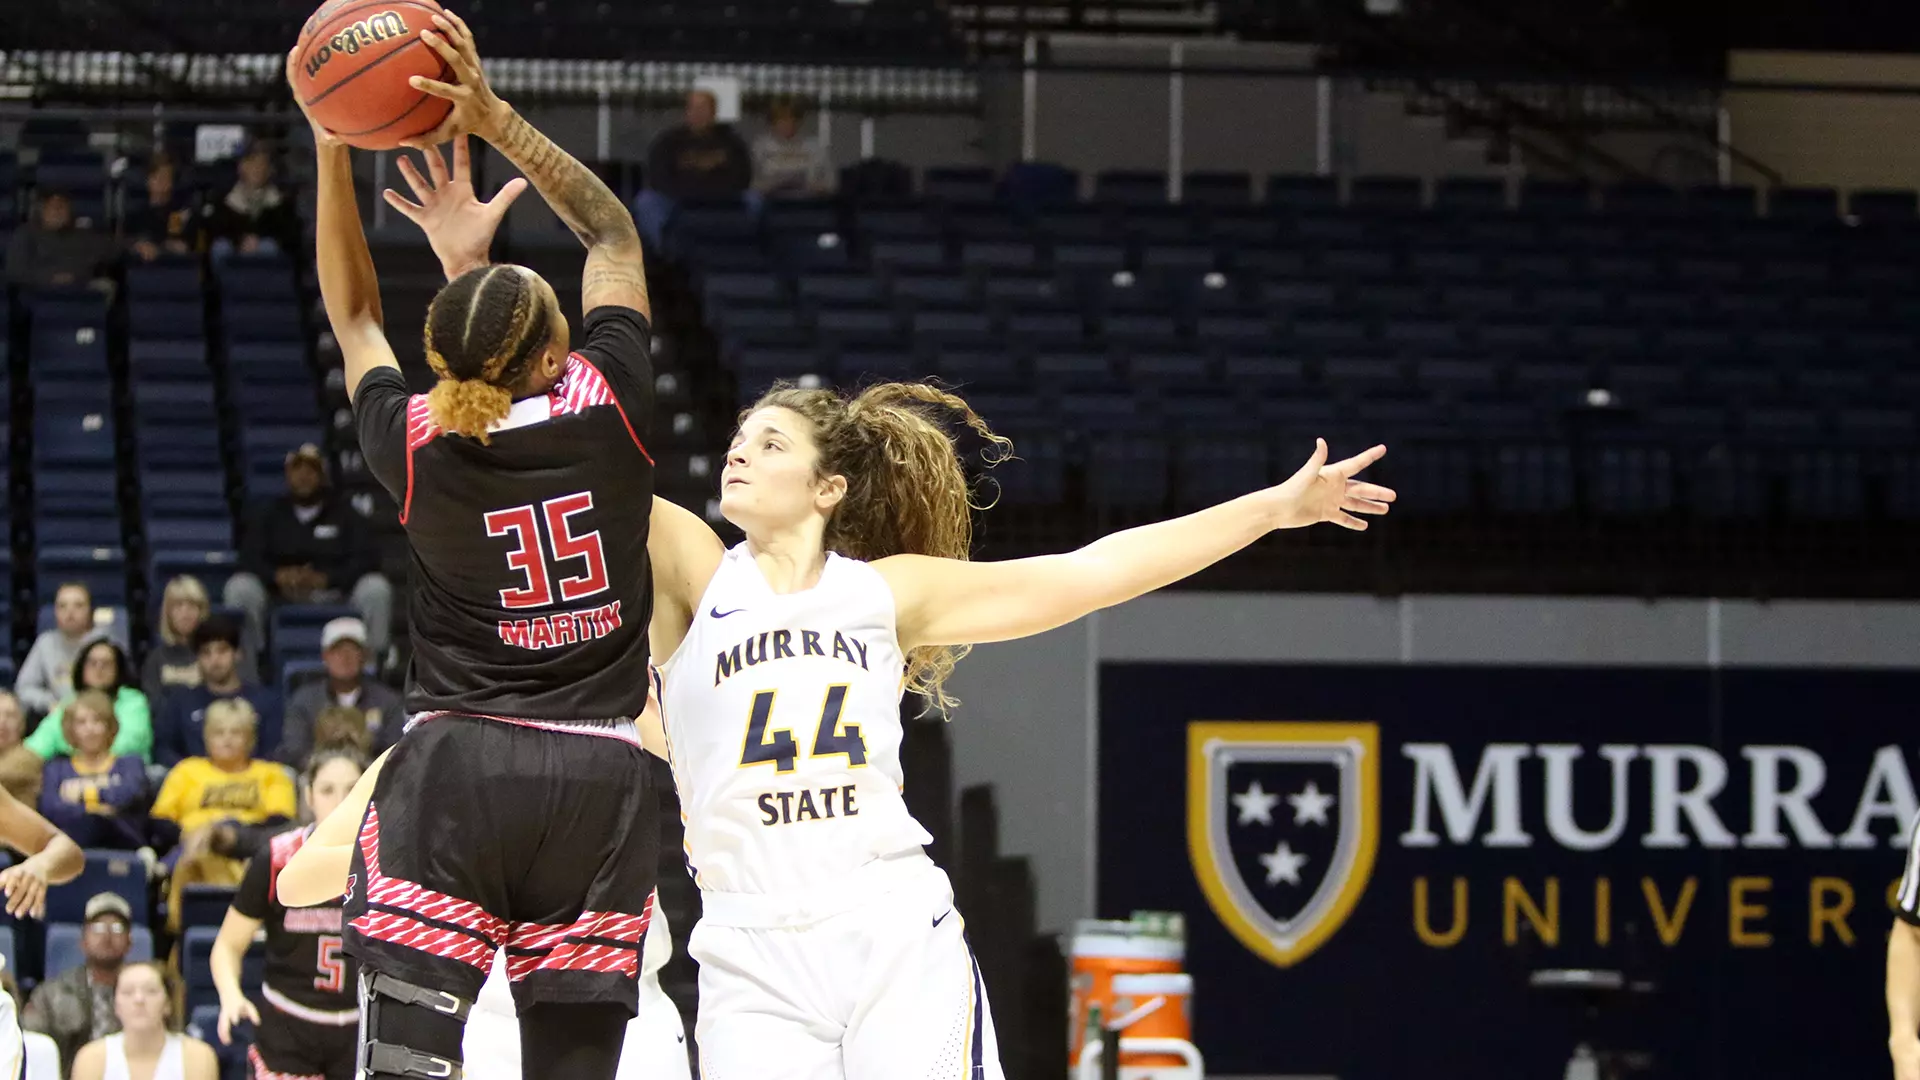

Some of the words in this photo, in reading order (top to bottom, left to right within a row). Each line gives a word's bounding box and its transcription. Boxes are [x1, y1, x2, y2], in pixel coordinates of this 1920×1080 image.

[305, 10, 410, 78] Wilson
[483, 491, 610, 609] 35
[498, 600, 623, 650] MARTIN
[714, 629, 870, 688] MURRAY
[737, 682, 870, 776] 44
[757, 784, 859, 826] STATE
[1399, 742, 1920, 851] MURRA
[313, 935, 346, 994] 5
